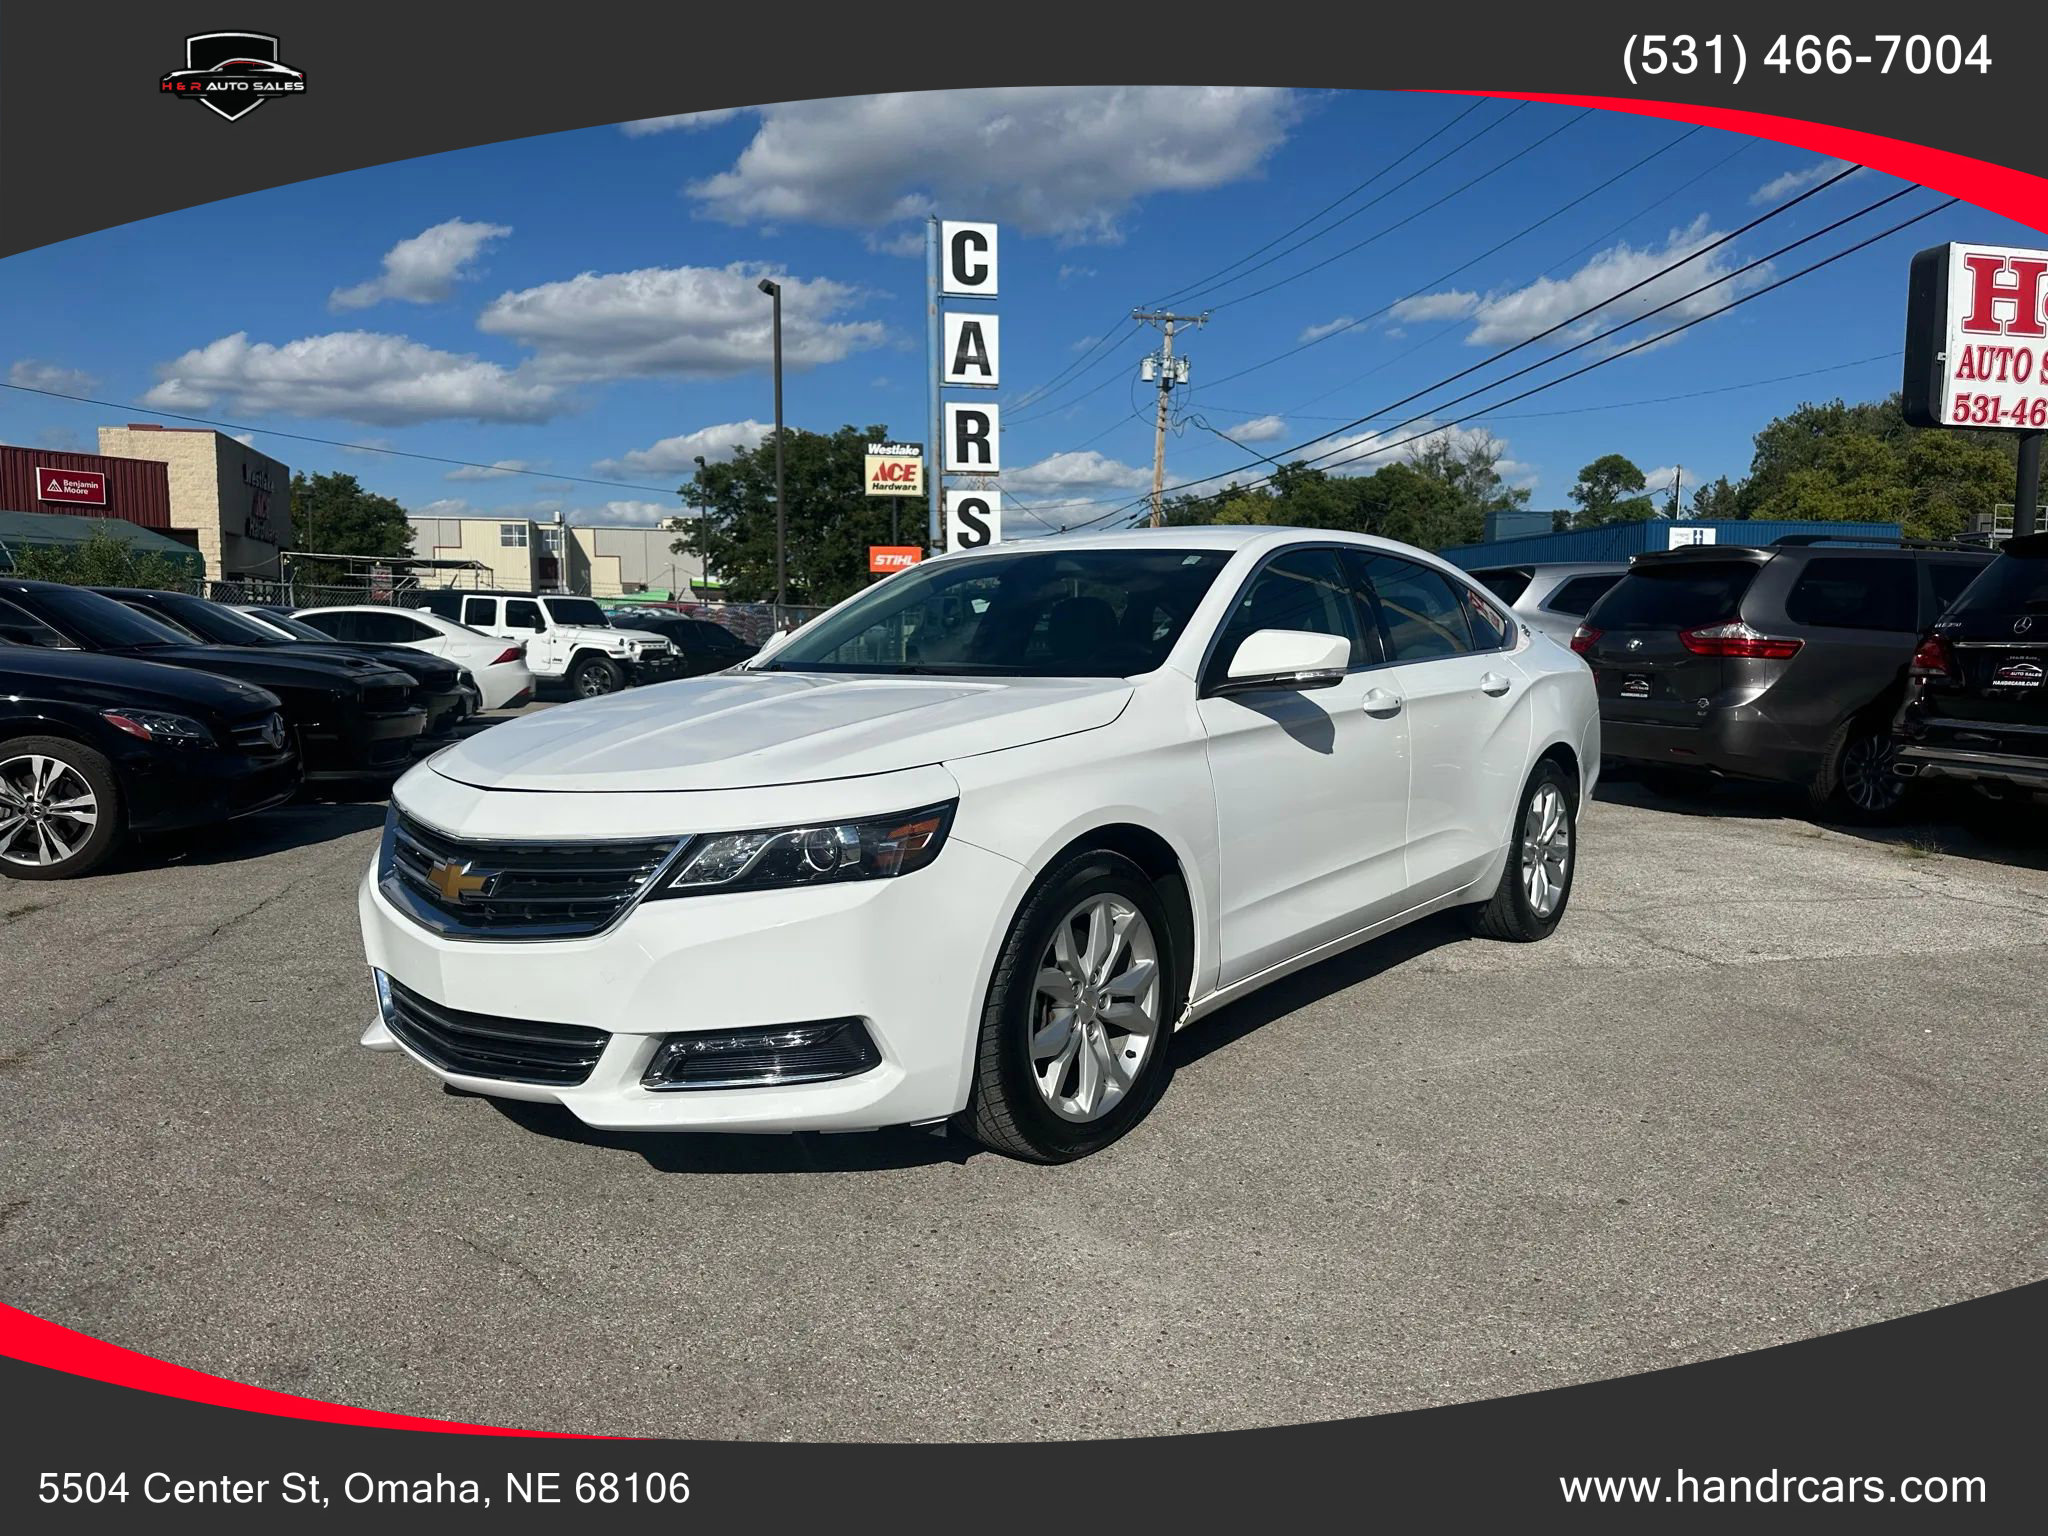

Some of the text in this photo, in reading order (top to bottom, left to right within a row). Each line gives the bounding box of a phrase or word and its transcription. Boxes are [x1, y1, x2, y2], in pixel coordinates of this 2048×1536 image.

[1954, 344, 2033, 384] AUTO
[951, 229, 992, 549] CARS
[868, 443, 920, 456] Westlake
[872, 460, 917, 482] ACE
[63, 479, 98, 489] Benjamin
[872, 483, 917, 491] Hardware
[64, 487, 88, 495] Moore
[874, 554, 916, 566] STIHL
